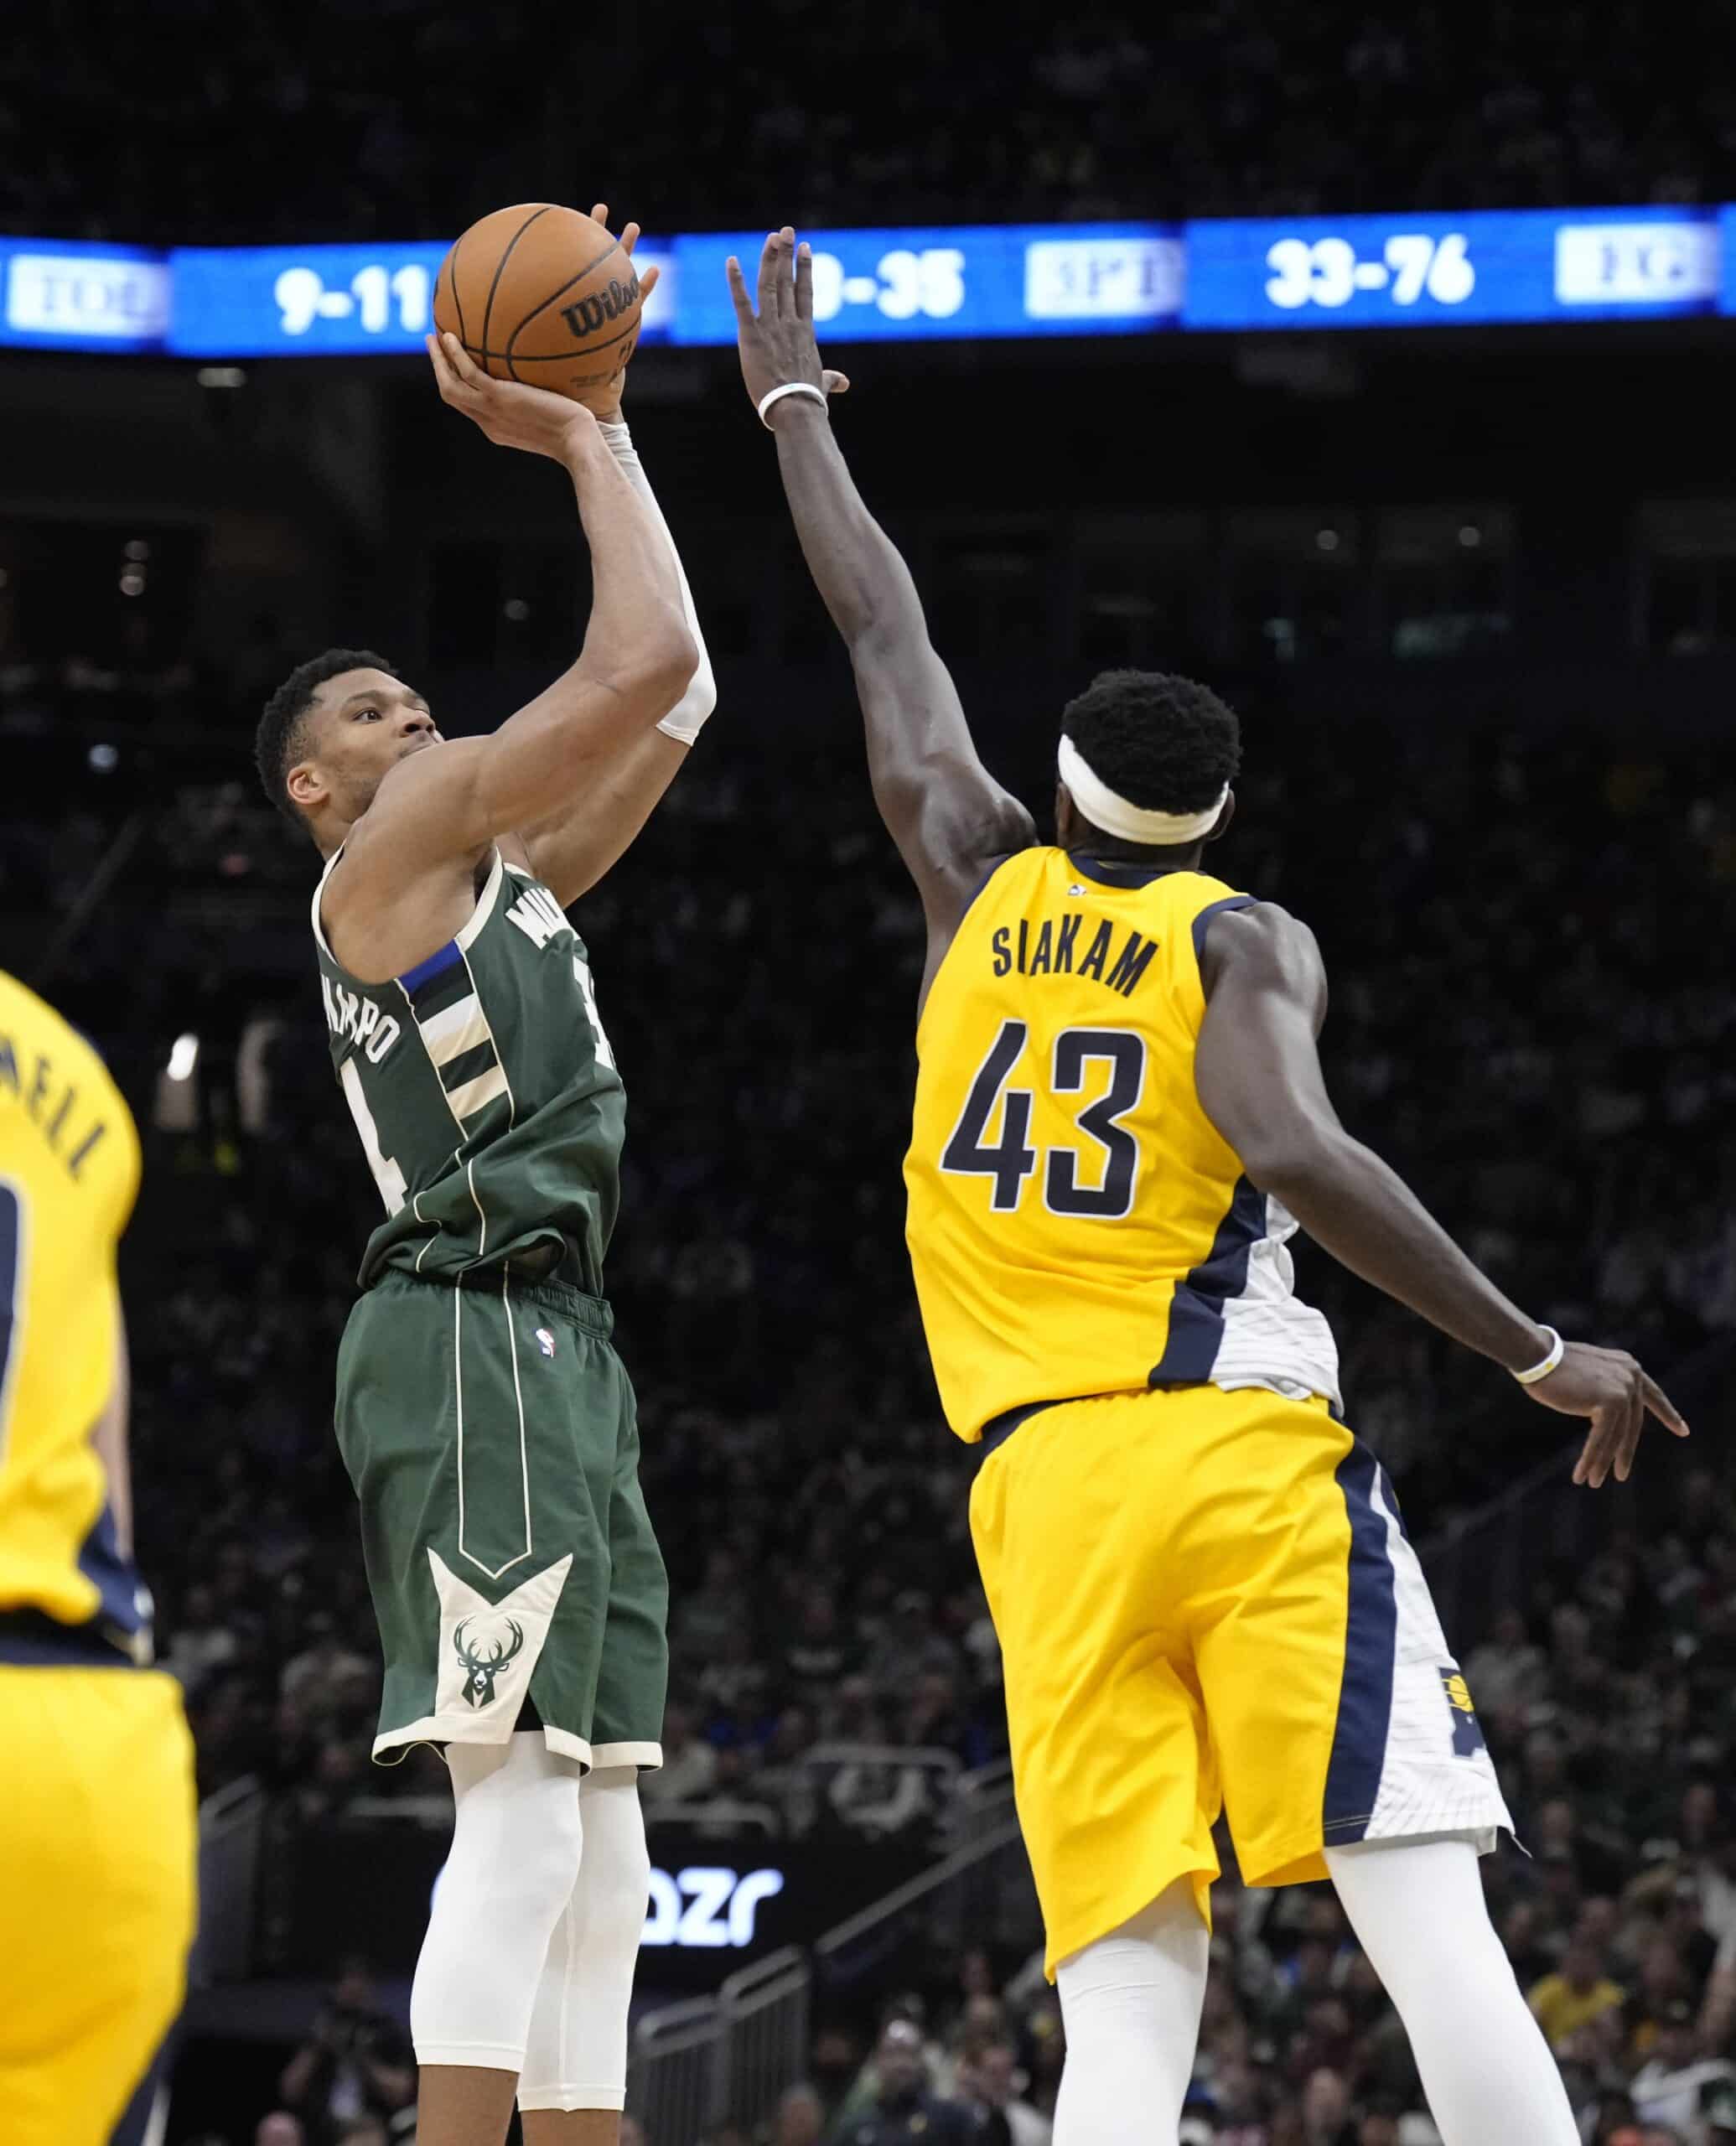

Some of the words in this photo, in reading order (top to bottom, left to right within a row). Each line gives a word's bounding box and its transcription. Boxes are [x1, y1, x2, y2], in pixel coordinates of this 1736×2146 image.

[274, 264, 429, 336] 9-11
[1265, 232, 1475, 309] 33-76
[992, 913, 1160, 998] SIAKAM
[939, 1017, 1148, 1221] 43
